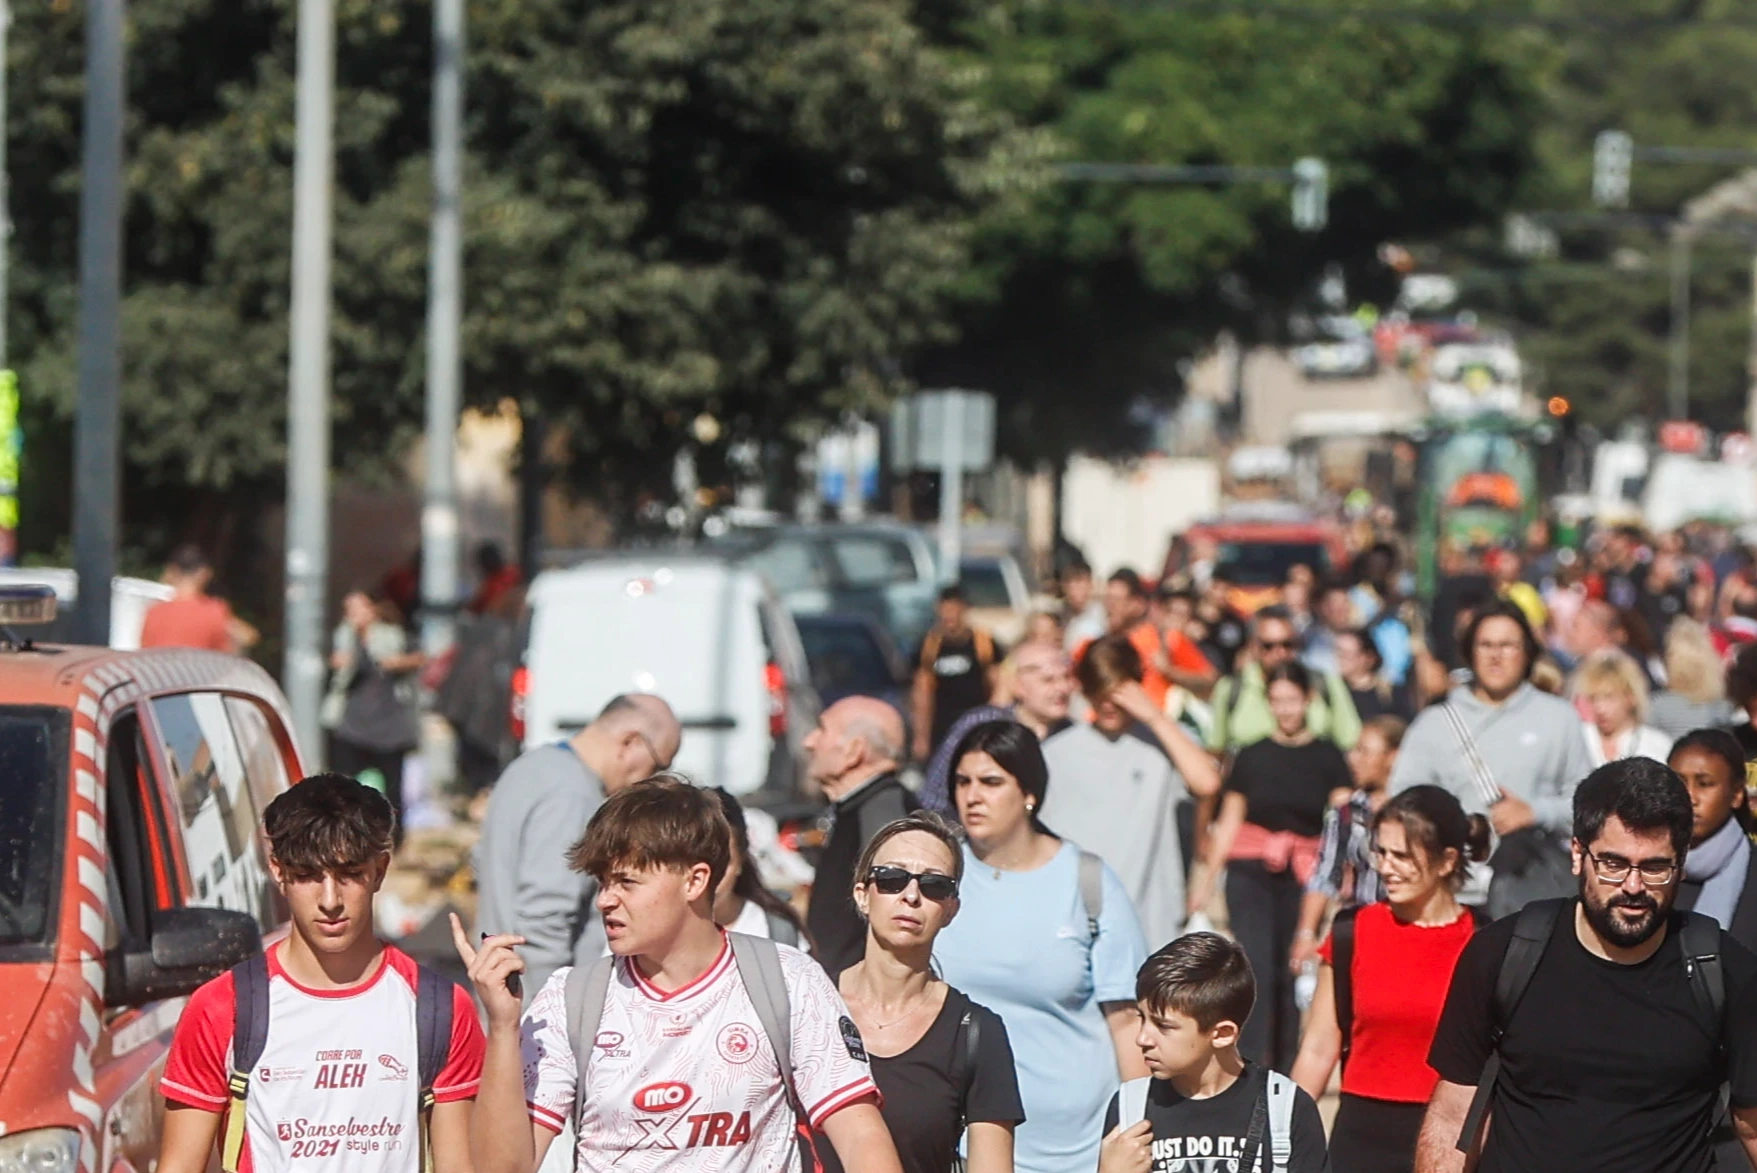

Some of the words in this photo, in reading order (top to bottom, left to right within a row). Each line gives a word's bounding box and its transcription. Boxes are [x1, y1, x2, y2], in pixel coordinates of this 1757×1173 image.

[316, 1050, 342, 1062] CORRE
[344, 1049, 363, 1060] POR
[294, 1116, 404, 1139] Sanselvestre
[291, 1139, 340, 1159] 2021
[346, 1140, 380, 1155] style
[1186, 1136, 1213, 1157] DO
